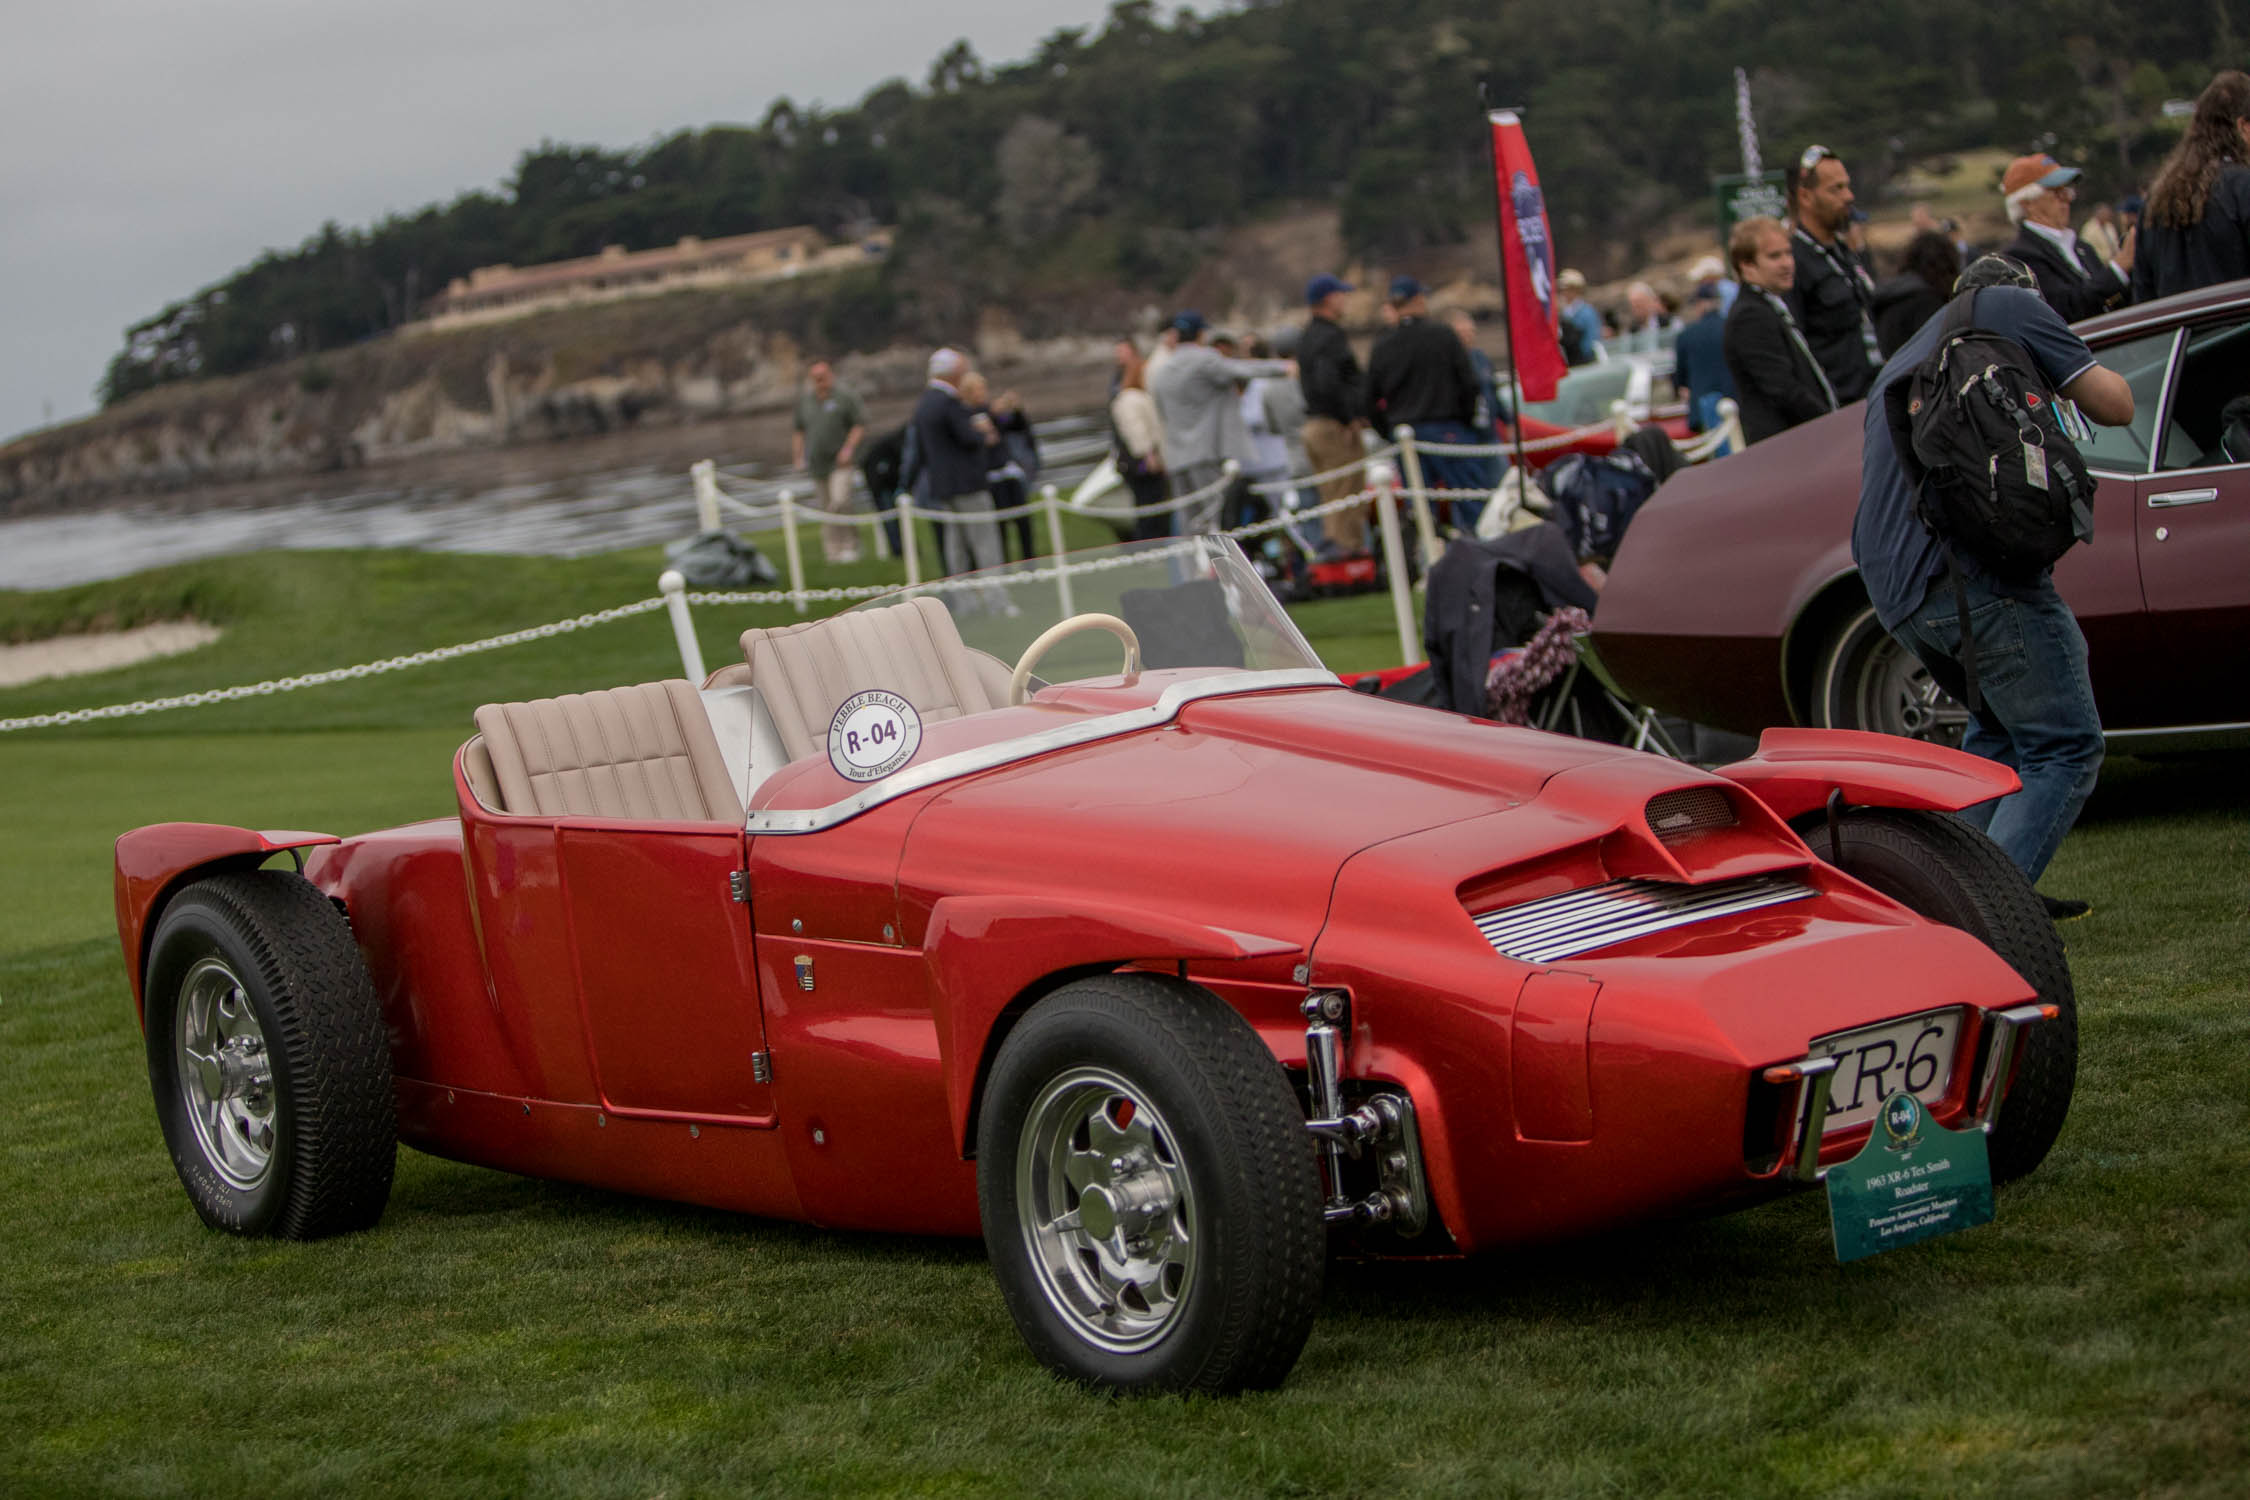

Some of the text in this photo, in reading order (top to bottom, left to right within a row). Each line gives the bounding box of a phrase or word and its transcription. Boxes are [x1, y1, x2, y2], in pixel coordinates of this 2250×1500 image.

[833, 693, 907, 733] PEBBLE BEACH
[846, 719, 897, 754] R-04
[848, 767, 866, 778] Tour
[1866, 1158, 1951, 1190] 1963 XR-6 Tex Smith
[1895, 1182, 1929, 1199] Roadster
